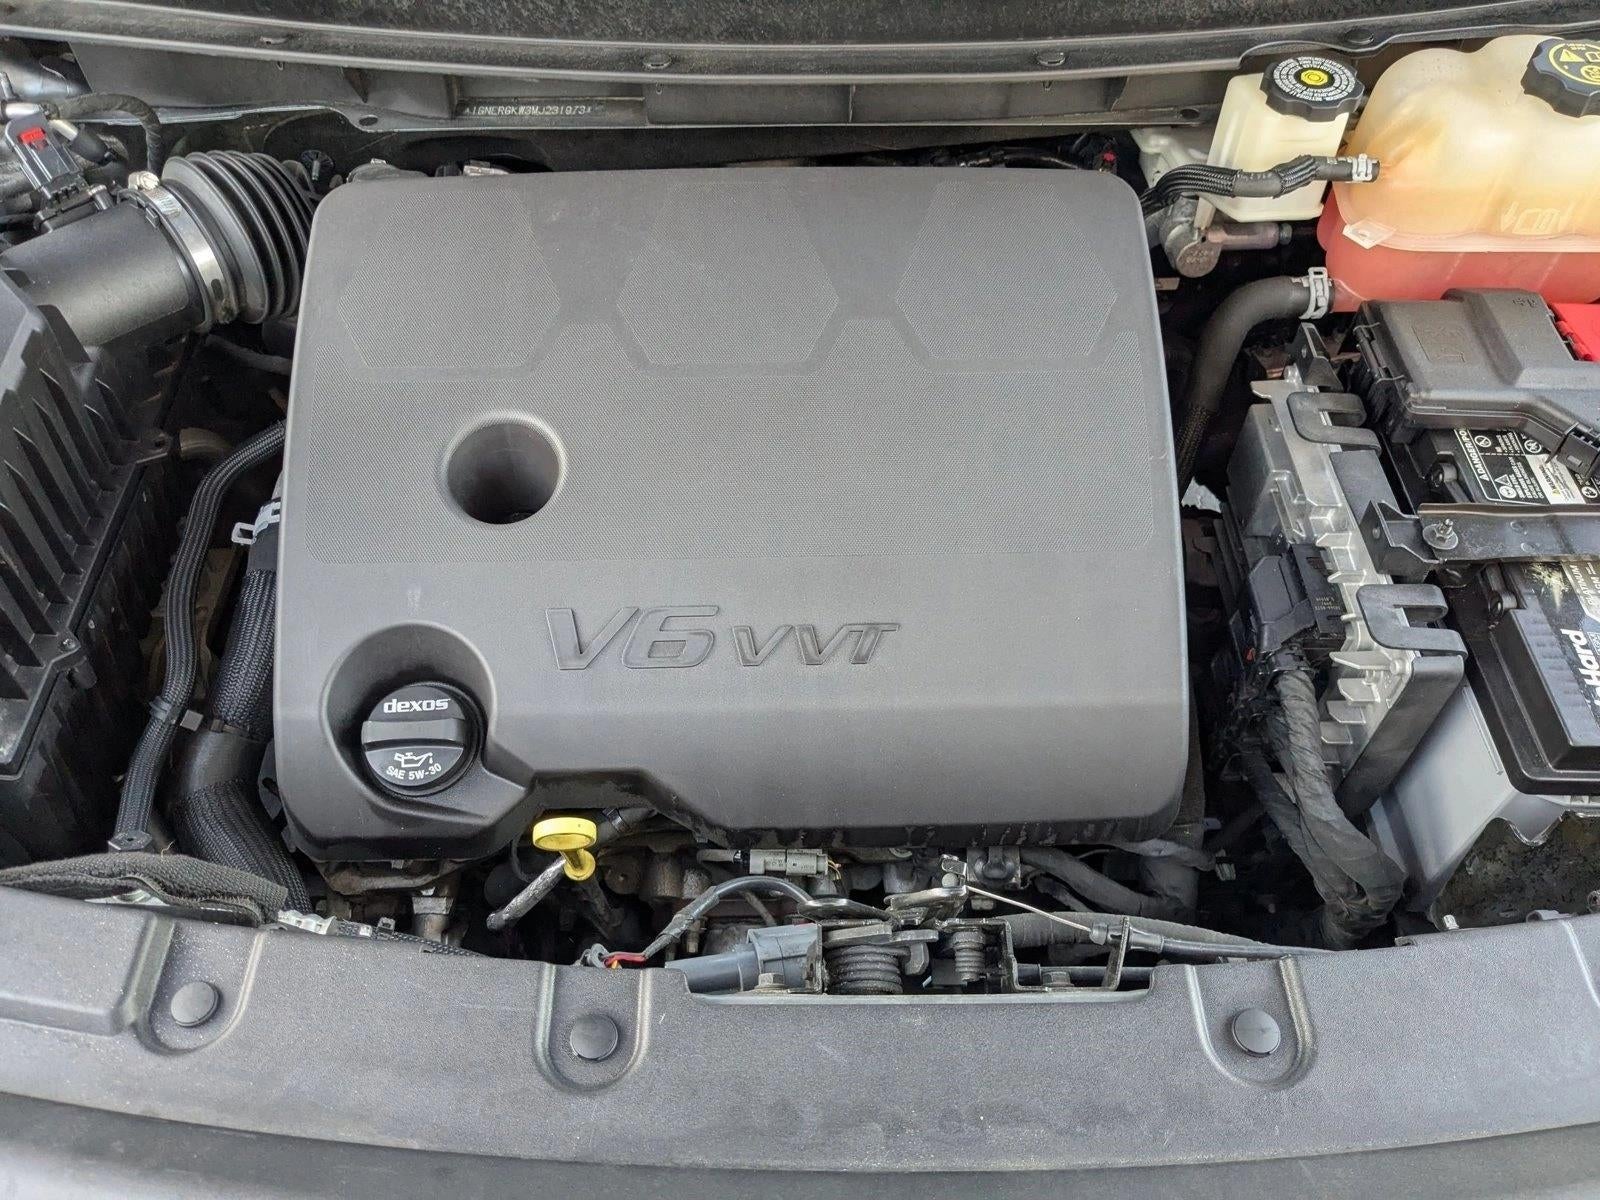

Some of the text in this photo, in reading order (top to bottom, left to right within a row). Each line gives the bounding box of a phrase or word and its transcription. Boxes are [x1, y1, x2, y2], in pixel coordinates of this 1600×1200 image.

[1459, 430, 1487, 474] DANGER/PO
[545, 605, 900, 671] V6 VVT
[383, 698, 451, 713] dexos
[386, 763, 442, 780] SAE 5W-30
